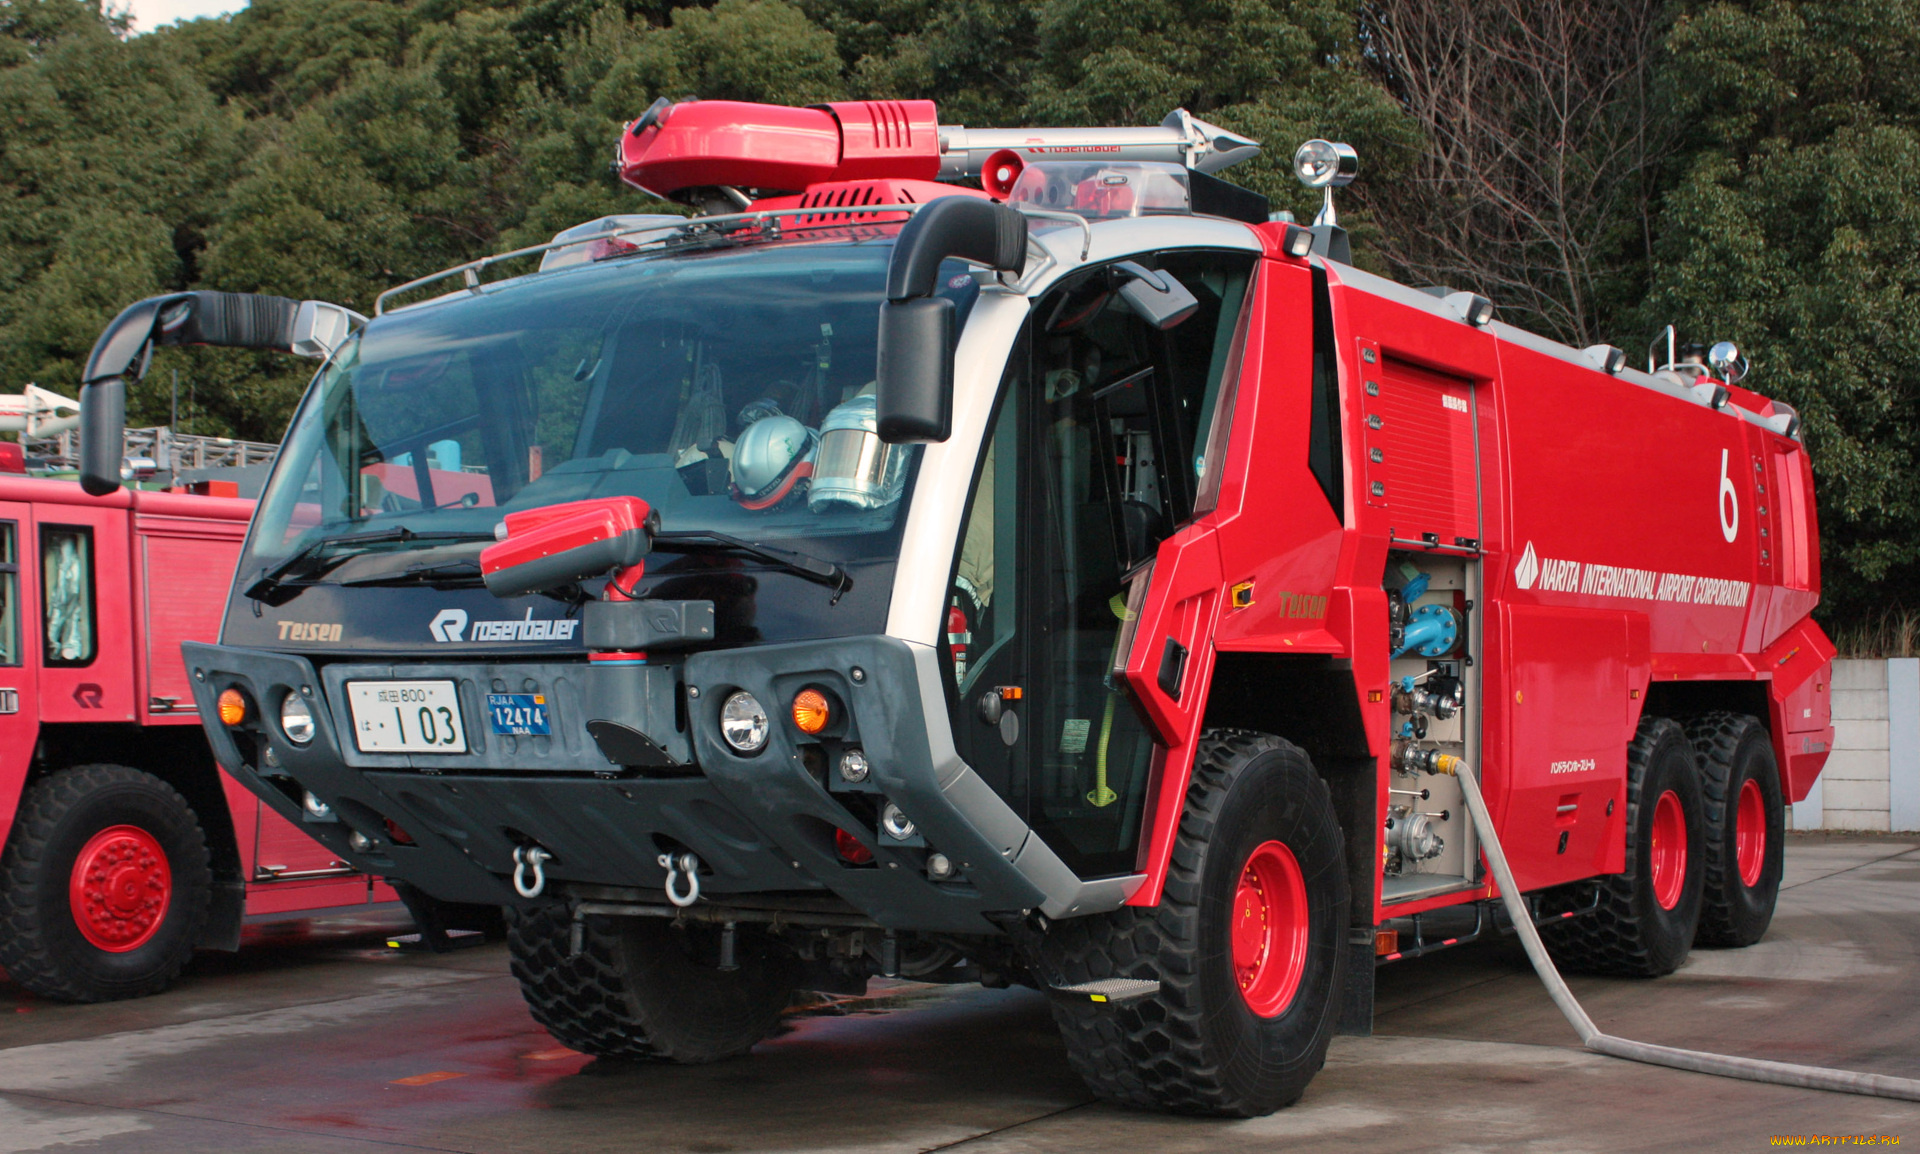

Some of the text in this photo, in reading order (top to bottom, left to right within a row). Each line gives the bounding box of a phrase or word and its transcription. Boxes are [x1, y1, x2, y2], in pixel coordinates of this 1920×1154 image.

[1719, 448, 1739, 543] 6
[1538, 558, 1750, 608] NARITA INTERNATIONAL AIRPORT CORPORATION
[277, 620, 343, 642] Teisen
[471, 606, 579, 641] rosenbauer
[489, 696, 515, 705] RJAA
[496, 707, 543, 725] 12474
[512, 726, 531, 734] NAA
